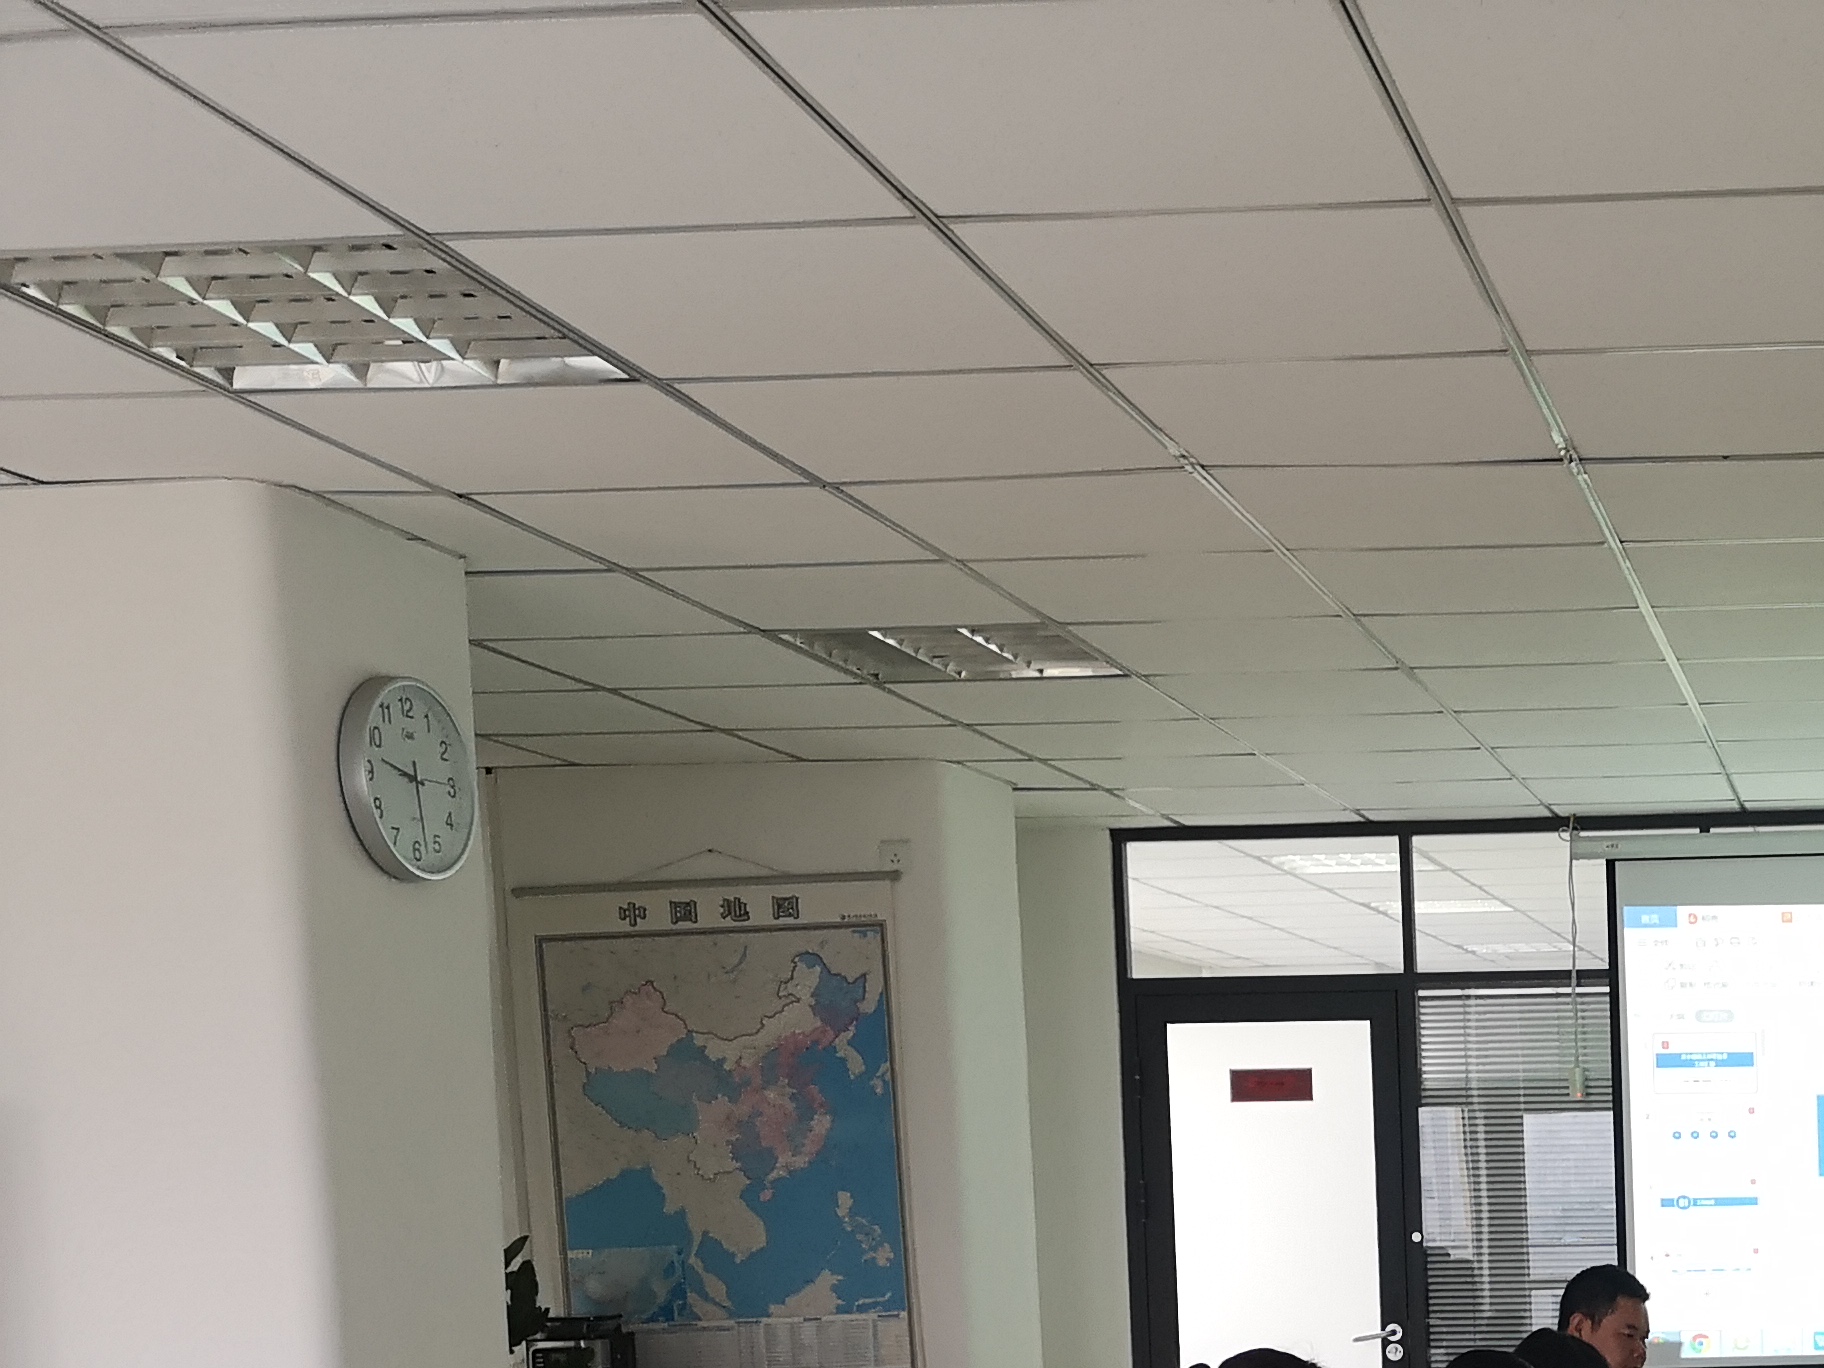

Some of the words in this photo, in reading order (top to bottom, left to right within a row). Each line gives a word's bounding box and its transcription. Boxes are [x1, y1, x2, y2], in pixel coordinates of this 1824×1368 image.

[379, 702, 392, 725] 11
[398, 697, 414, 719] 12
[424, 713, 431, 733] 1
[369, 726, 382, 748] 10
[439, 740, 451, 762] 2
[366, 759, 374, 781] 9
[447, 777, 457, 798] 3
[373, 797, 384, 820] 8
[445, 811, 454, 831] 4
[391, 826, 400, 847] 7
[433, 834, 442, 854] 5
[412, 840, 422, 862] 6
[618, 895, 800, 927] 中国地图
